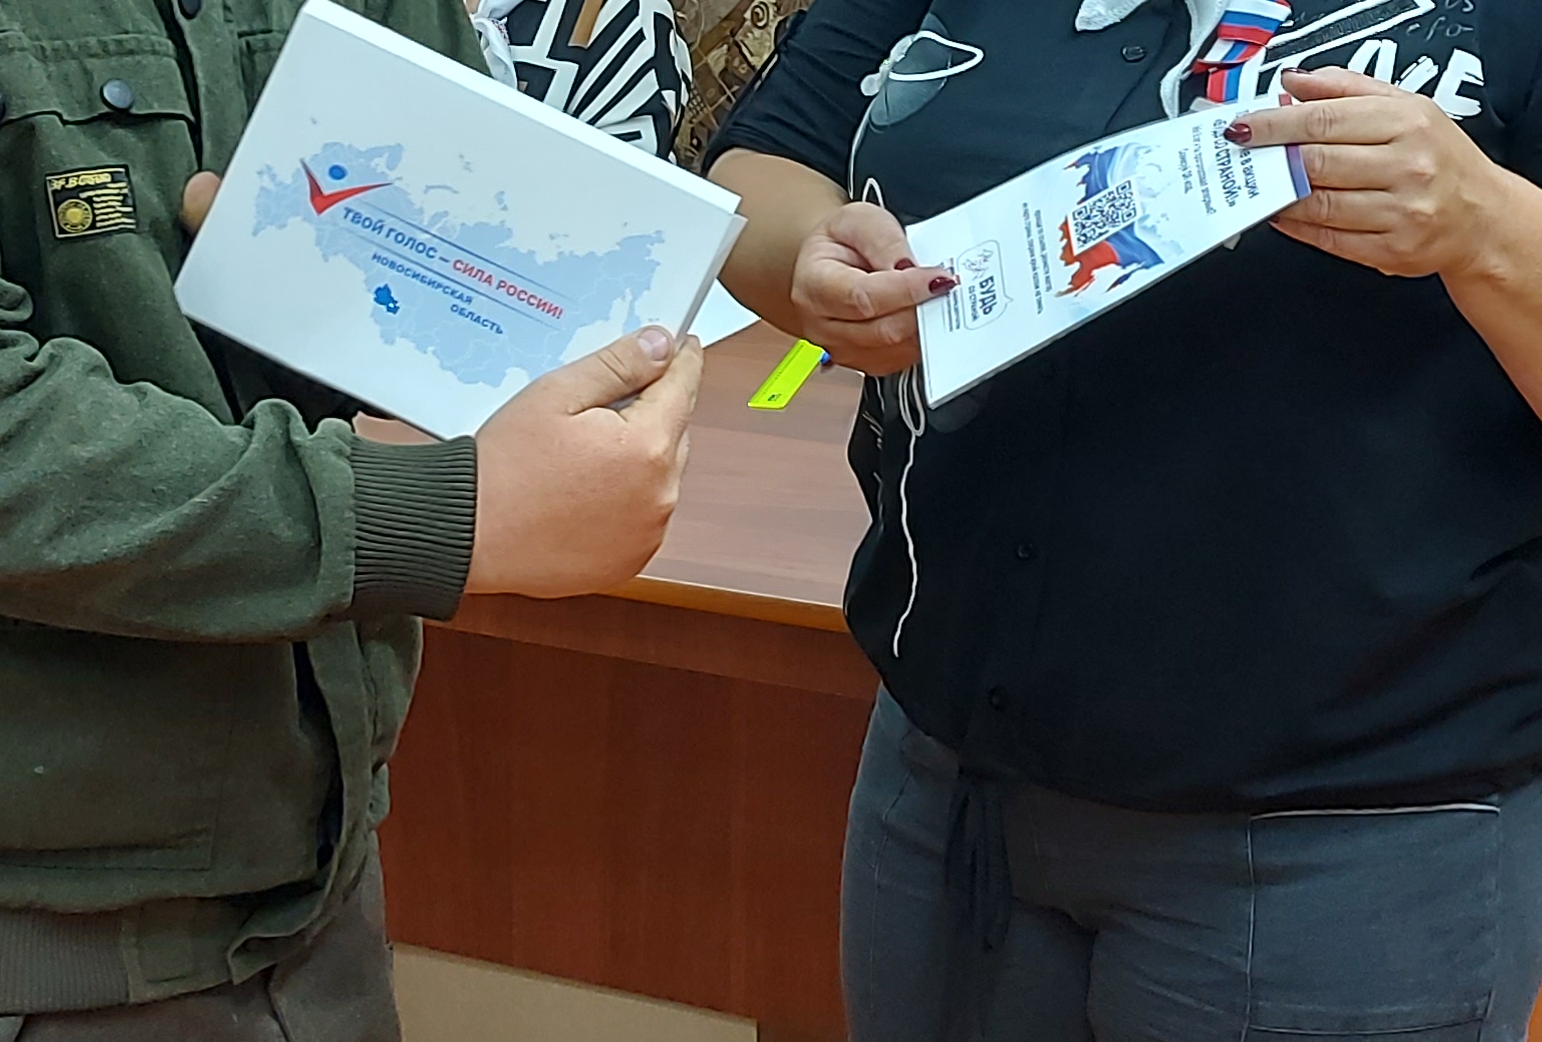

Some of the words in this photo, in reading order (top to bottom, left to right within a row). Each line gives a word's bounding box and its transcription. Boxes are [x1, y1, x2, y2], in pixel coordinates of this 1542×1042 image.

[343, 206, 385, 236] ТВОЙ
[386, 227, 438, 260] ГОЛОС
[452, 258, 493, 287] СИЛА
[496, 279, 563, 320] РОССИИ!
[371, 251, 473, 306] НОВОСИБИРСКАЯ
[450, 303, 504, 336] ОБЛАСТЬ
[979, 275, 997, 316] БУДЬ
